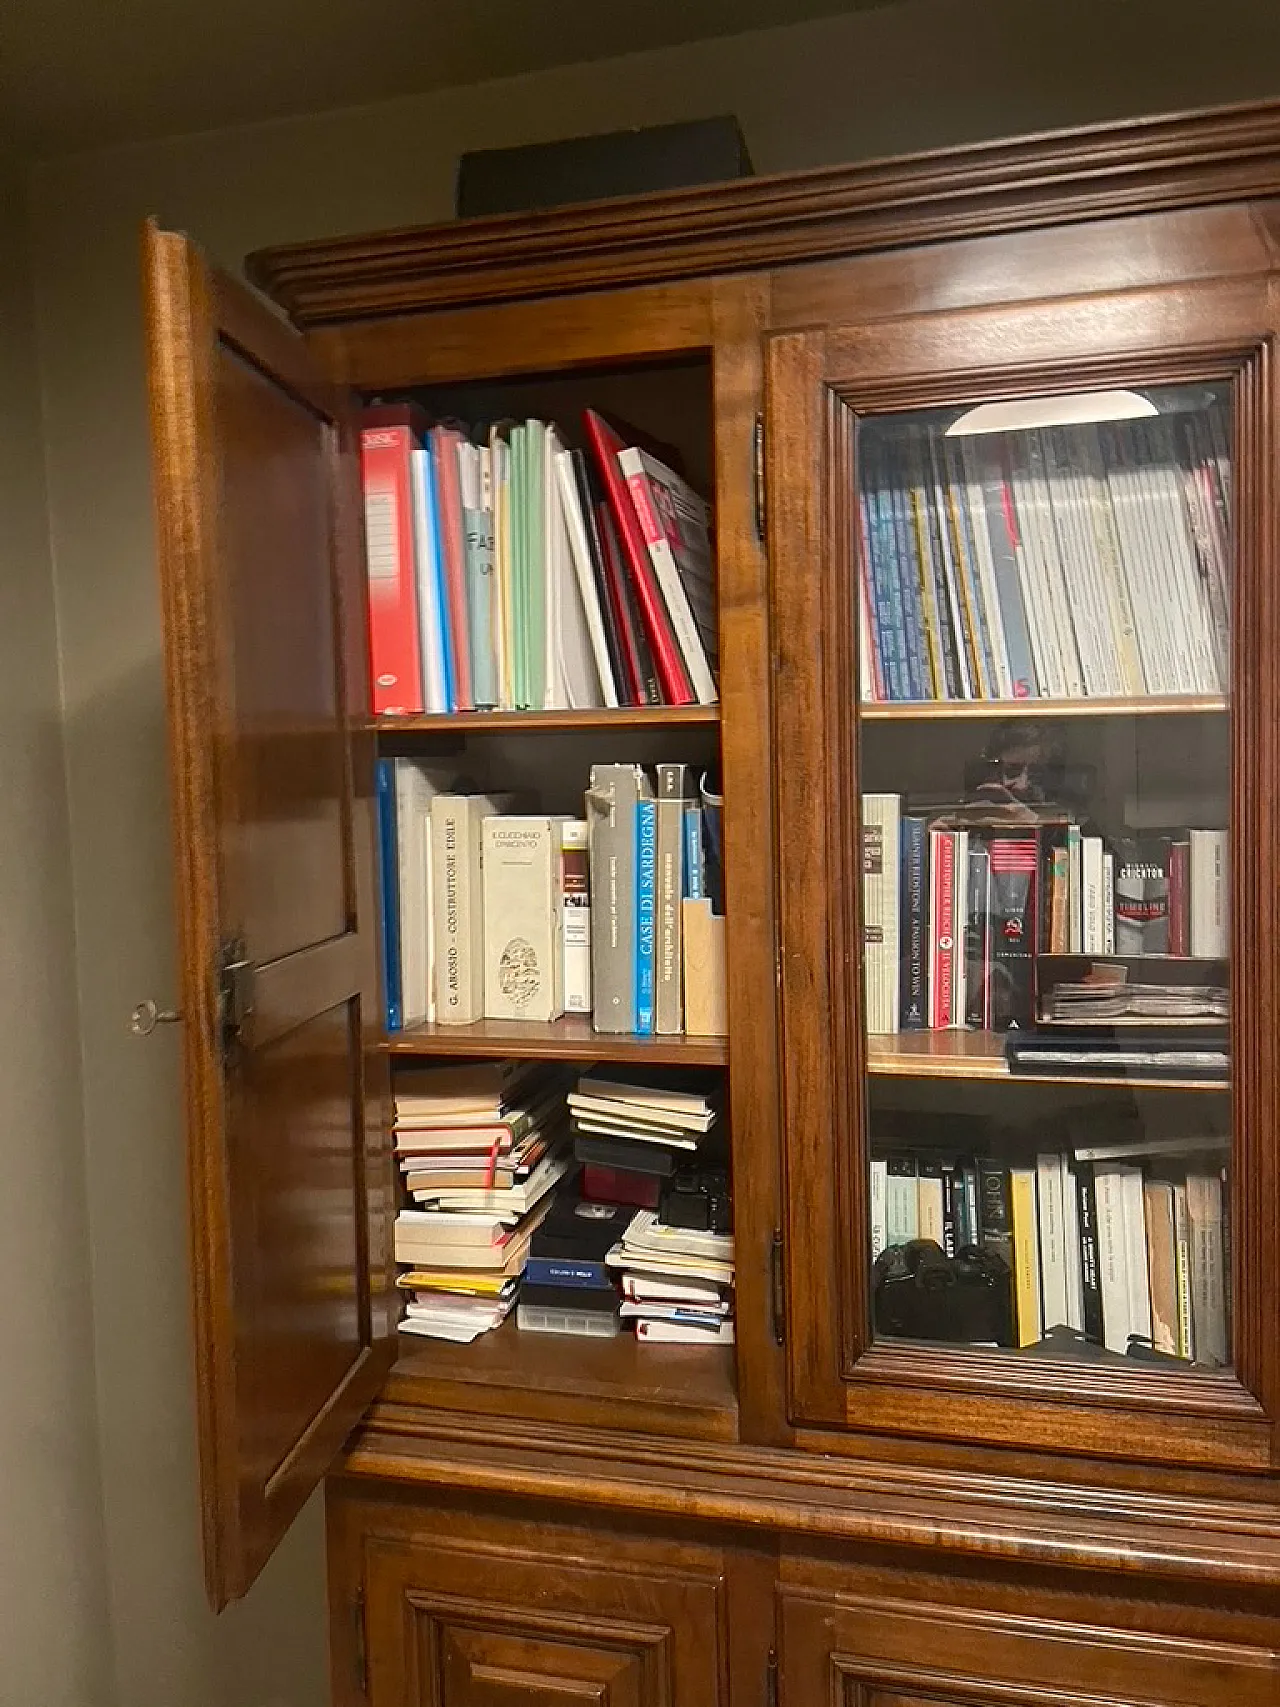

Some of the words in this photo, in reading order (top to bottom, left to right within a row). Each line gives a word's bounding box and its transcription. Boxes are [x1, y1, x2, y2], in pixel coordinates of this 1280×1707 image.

[640, 803, 654, 888] SARDEGNA
[1120, 868, 1164, 879] CRICHTON
[640, 894, 653, 911] DI
[640, 916, 652, 955] CASE
